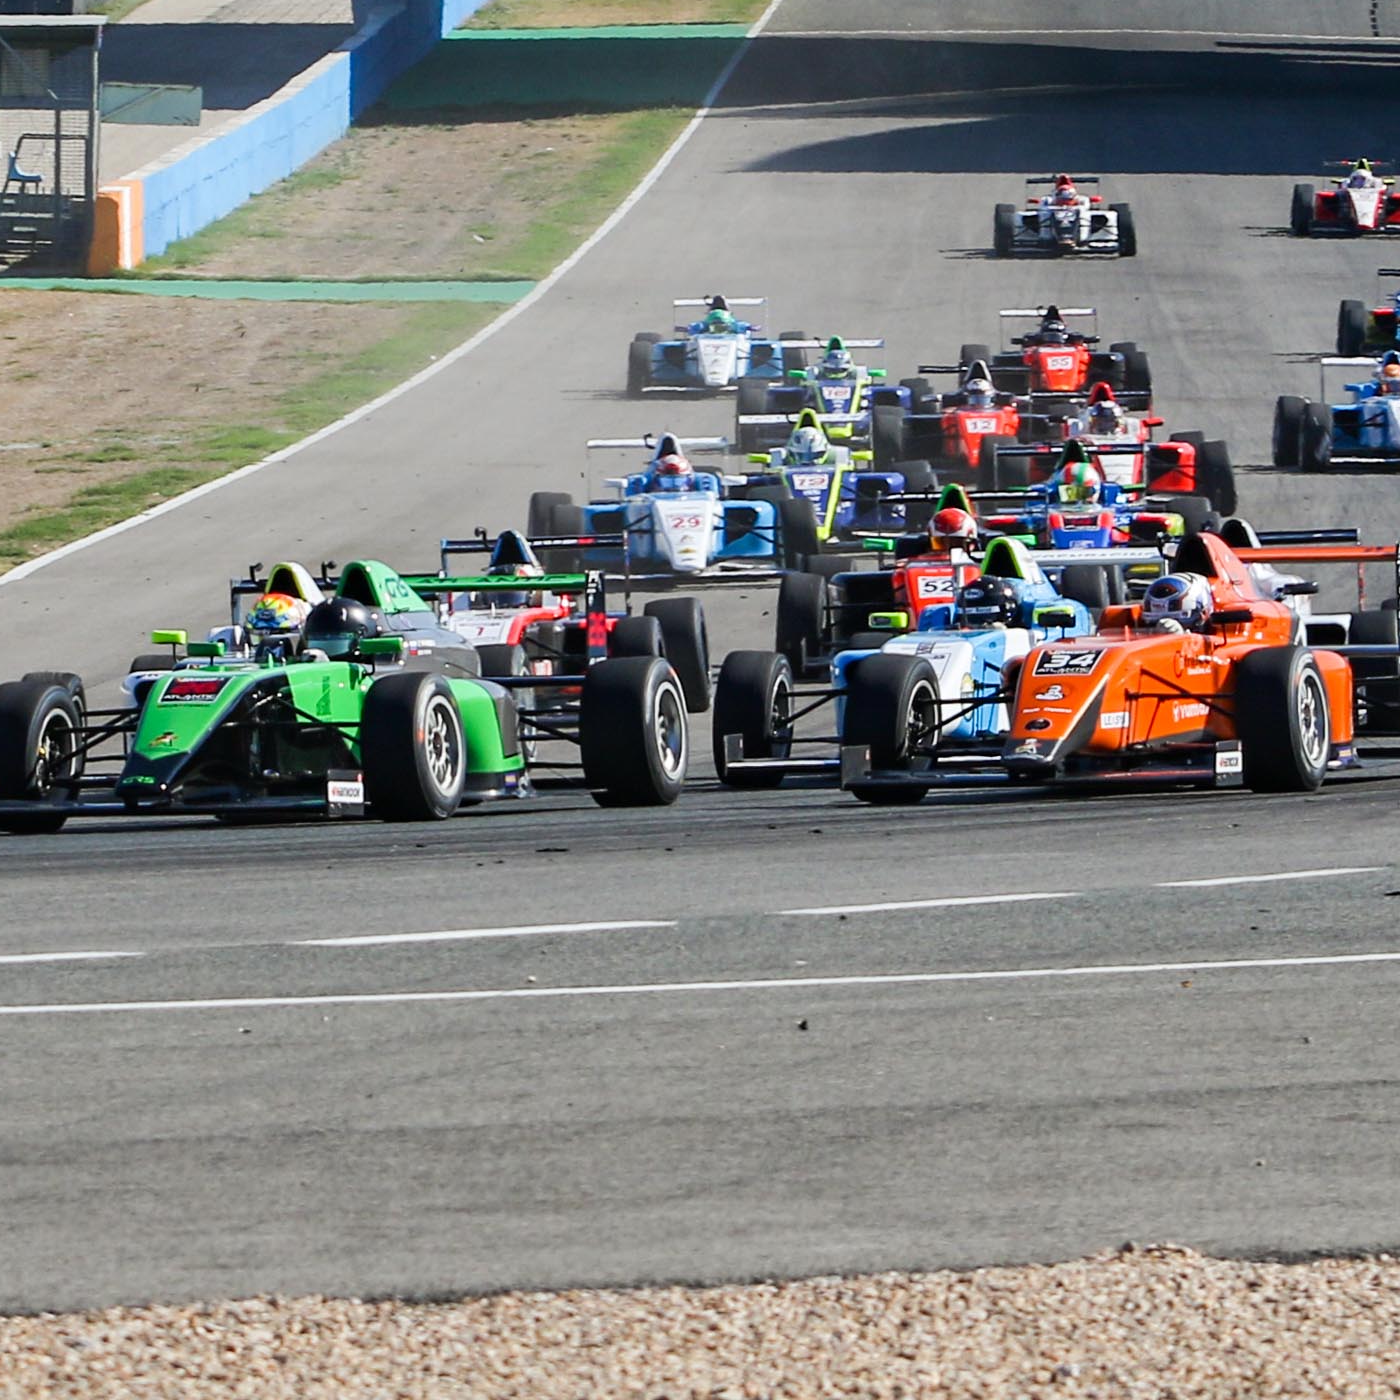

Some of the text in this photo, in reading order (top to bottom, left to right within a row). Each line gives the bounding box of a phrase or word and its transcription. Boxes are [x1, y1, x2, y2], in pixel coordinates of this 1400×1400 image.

[970, 418, 993, 431] 12
[671, 516, 701, 529] 29
[923, 580, 955, 593] 52
[1043, 653, 1096, 668] 34
